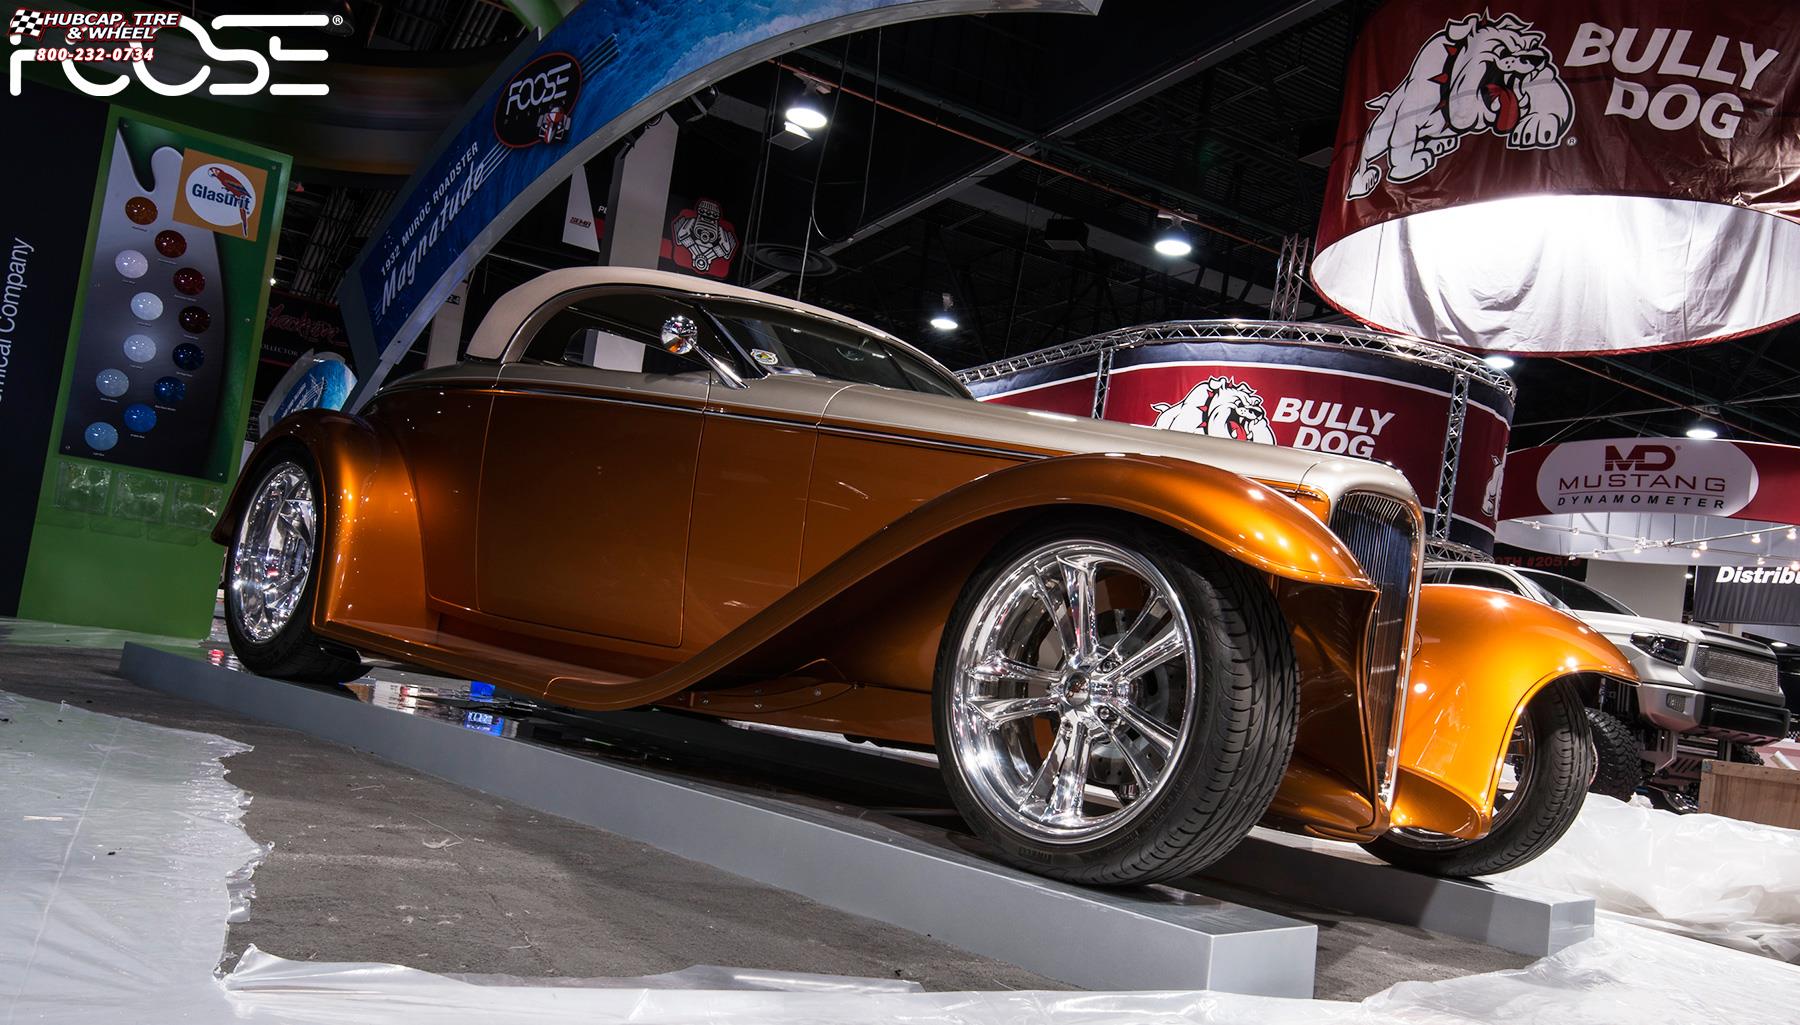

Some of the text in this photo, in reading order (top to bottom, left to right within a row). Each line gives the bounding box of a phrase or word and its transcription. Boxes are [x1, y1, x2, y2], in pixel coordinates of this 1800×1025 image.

[1563, 22, 1780, 91] BULLY
[506, 62, 571, 115] FOOSE
[1604, 77, 1744, 139] DOG
[192, 183, 251, 210] Glasurit
[381, 141, 479, 276] 1932 MUROC ROADSTER
[382, 161, 484, 315] Magnatude
[0, 237, 34, 333] Company
[1271, 397, 1396, 435] BULLY
[1293, 426, 1376, 459] DOG
[1604, 444, 1676, 471] MD
[1557, 494, 1725, 509] DYNAMOMETER
[1559, 474, 1726, 492] MUSTANG
